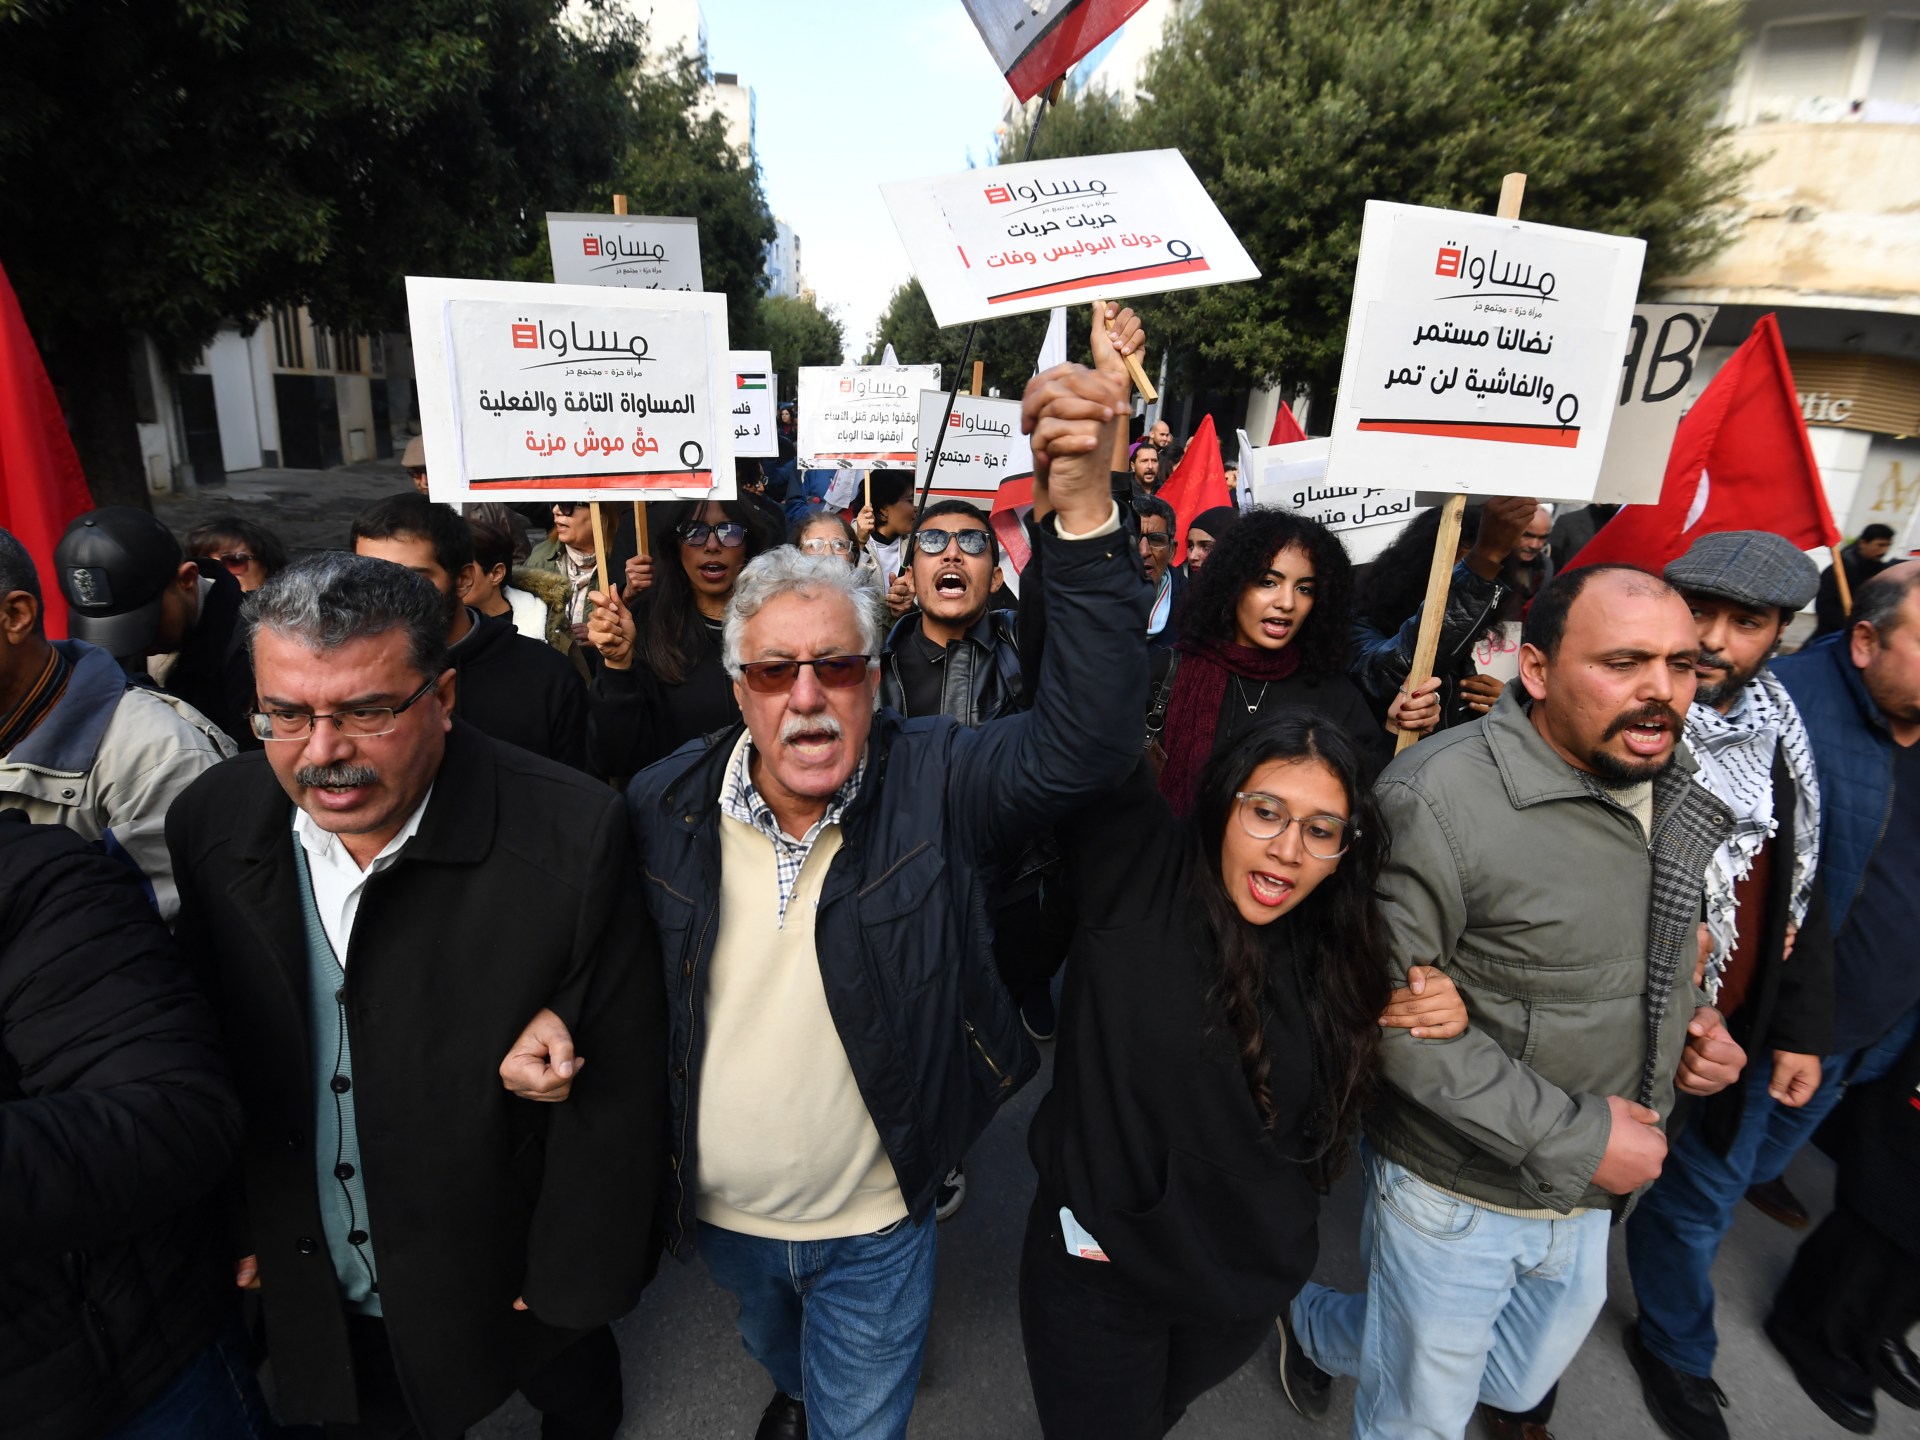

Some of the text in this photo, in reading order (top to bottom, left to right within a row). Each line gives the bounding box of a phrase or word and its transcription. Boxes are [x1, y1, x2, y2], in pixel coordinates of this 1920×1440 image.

[984, 179, 1107, 204] مساواة
[1007, 213, 1117, 237] حريات حريات
[582, 233, 665, 264] مساواة
[986, 232, 1162, 268] دولة البوليس وفات
[1435, 240, 1555, 302] مساواة
[1483, 304, 1507, 315] مجتمع
[511, 317, 649, 364] مساواة
[1413, 321, 1553, 355] نضالنا مستمر
[576, 368, 602, 378] مجتمع
[1384, 364, 1554, 405] والفاشية لن تمر
[840, 377, 906, 398] مساواة
[479, 389, 557, 418] والفعلية
[621, 392, 695, 418] المساواة
[732, 401, 751, 414] فلس
[1797, 390, 1853, 422] tic
[734, 424, 760, 439] لا حلو
[837, 428, 904, 443] أوقفوا هذا الوباء
[950, 410, 1011, 437] مساواة
[525, 430, 566, 457] مزية
[573, 427, 625, 458] موش
[939, 451, 971, 467] مجتمع
